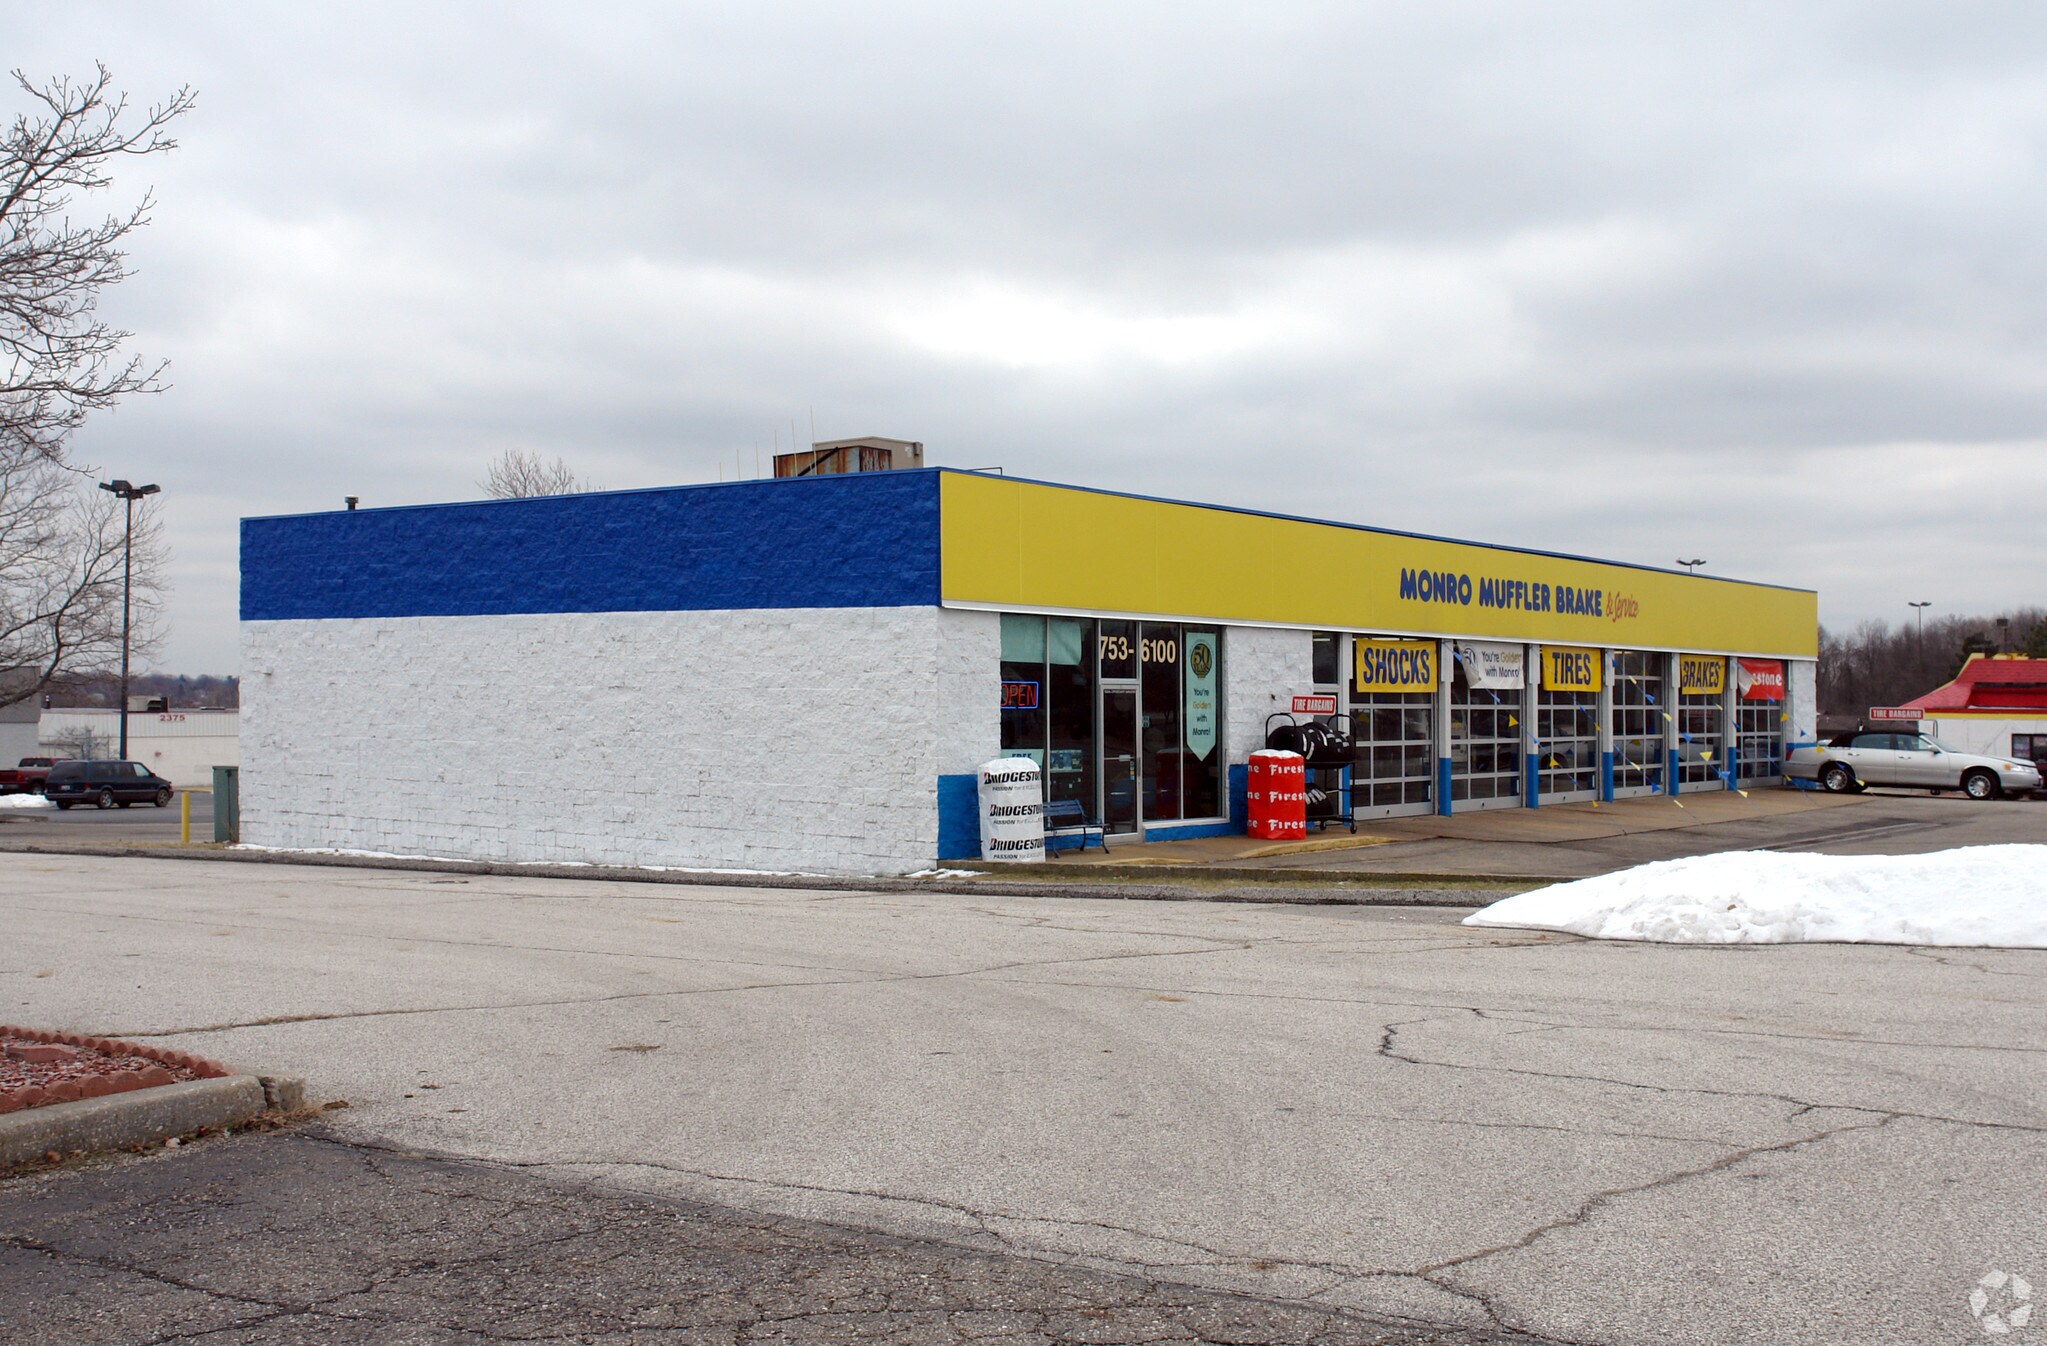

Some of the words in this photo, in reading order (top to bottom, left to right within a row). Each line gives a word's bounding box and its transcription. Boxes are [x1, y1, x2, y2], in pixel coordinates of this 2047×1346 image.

[1400, 568, 1472, 606] MONRO
[1479, 577, 1551, 612] MUFFLER
[1556, 585, 1602, 617] BRAKE
[1606, 591, 1613, 617] &
[1612, 591, 1639, 623] Service
[1100, 635, 1134, 660] 753-
[1141, 638, 1176, 664] 6100
[1363, 647, 1430, 685] SHOCKS
[1485, 664, 1498, 677] with
[1552, 652, 1591, 685] TIRES
[1683, 660, 1720, 687] BRAKES
[1001, 684, 1037, 706] OPEN
[1193, 687, 1210, 697] You're
[1192, 700, 1211, 710] Golden
[1294, 698, 1306, 711] TIRE
[1307, 699, 1334, 712] BARGAINS
[1873, 709, 1887, 718] TIRE
[1888, 709, 1922, 719] BARGAINS
[159, 714, 186, 722] 2375
